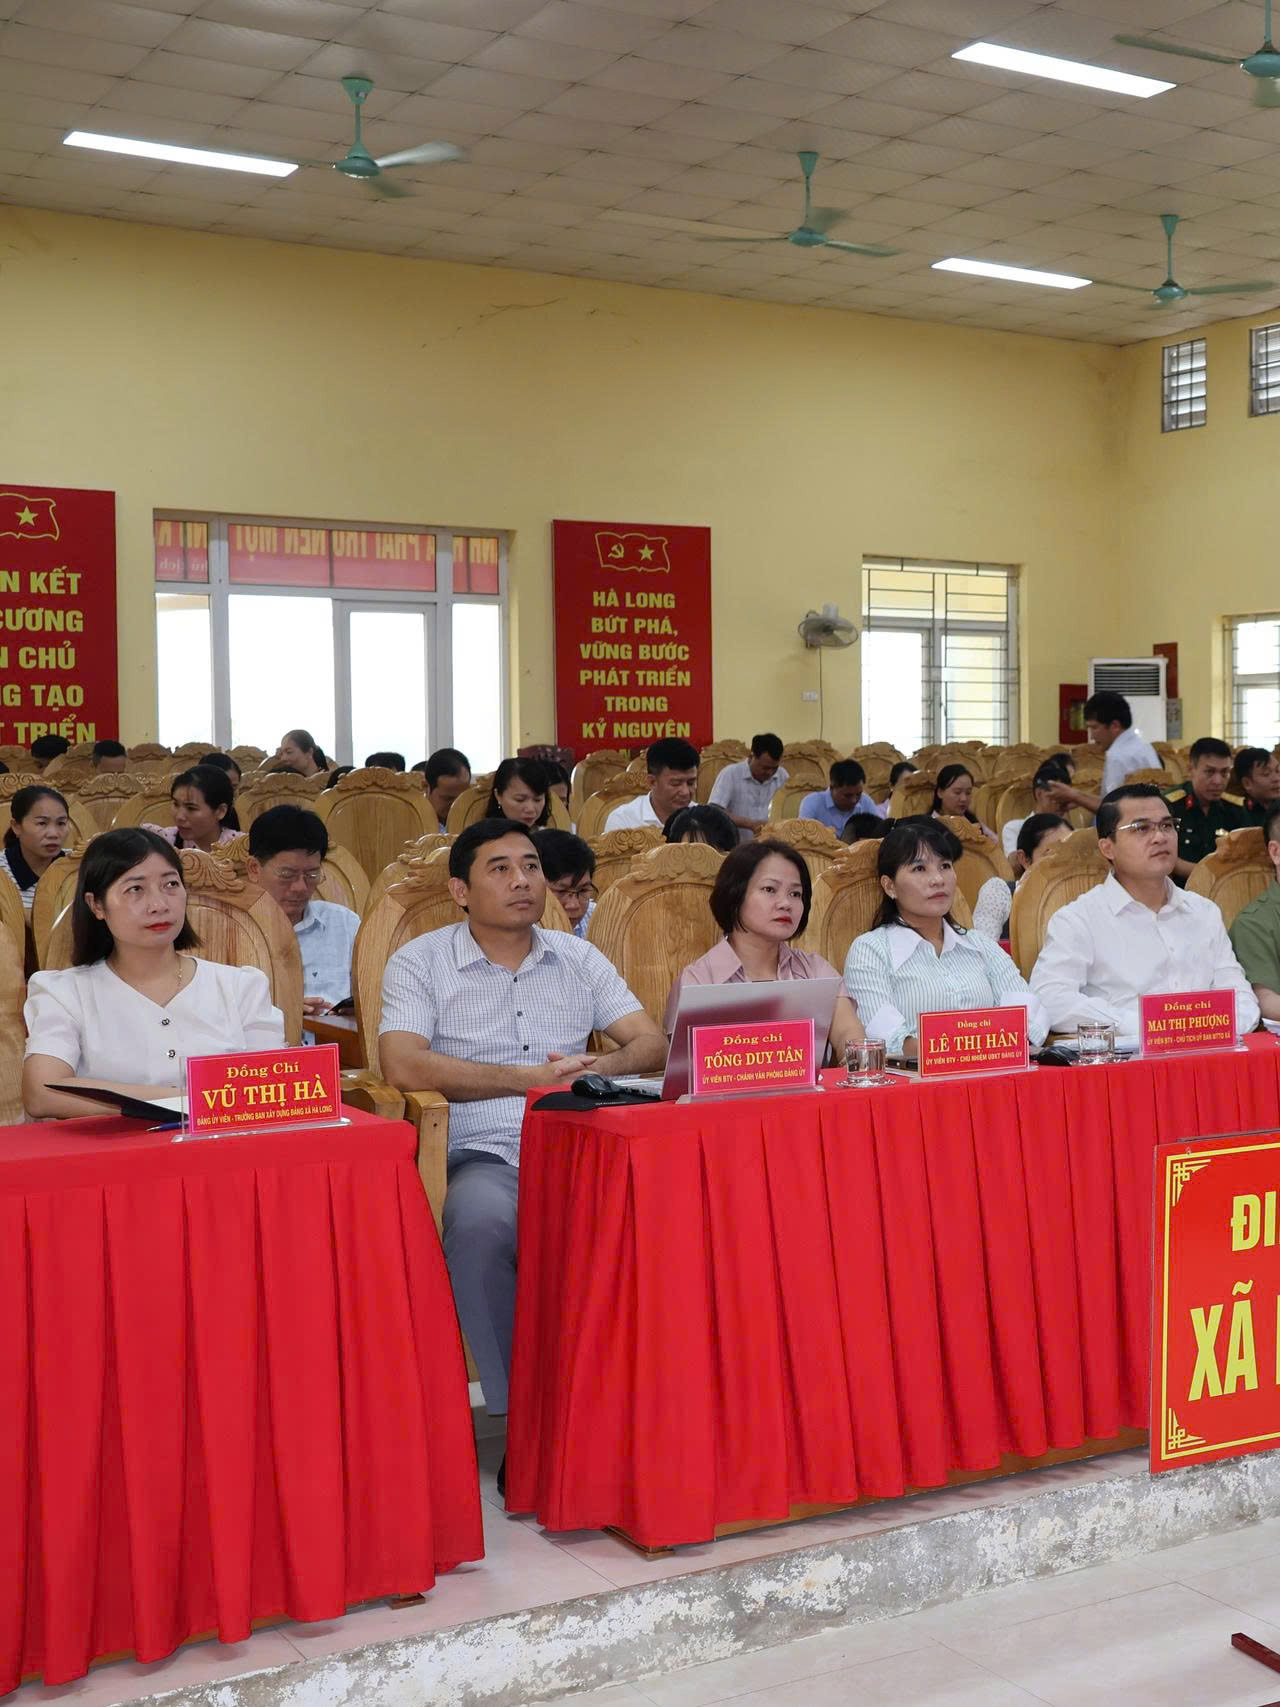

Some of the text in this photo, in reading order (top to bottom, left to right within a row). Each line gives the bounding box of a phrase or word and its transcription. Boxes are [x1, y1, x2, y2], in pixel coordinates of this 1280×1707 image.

[30, 566, 82, 595] KẾT
[593, 587, 676, 609] HÀ LONG
[591, 615, 678, 637] BỨT PHÁ,
[18, 640, 76, 670] CHỦ
[579, 641, 690, 662] VỮNG BƯỚC
[579, 665, 691, 687] PHÁT TRIỂN
[30, 684, 84, 711] TẠO
[604, 696, 668, 712] TRONG
[13, 714, 96, 745] TRIỂN
[582, 717, 691, 739] KỶ NGUYÊN
[1164, 1000, 1212, 1012] Đồng chí
[1148, 1013, 1230, 1032] MAI THỊ PHƯỢNG
[723, 1033, 783, 1046] Đồng chí
[928, 1028, 1019, 1054] LÊ THỊ HÂN
[704, 1046, 804, 1069] TỐNG DUY TÂN
[226, 1061, 299, 1079] Đồng Chí
[201, 1074, 328, 1110] VŨ THỊ HÀ
[1187, 1279, 1258, 1402] XÃ
